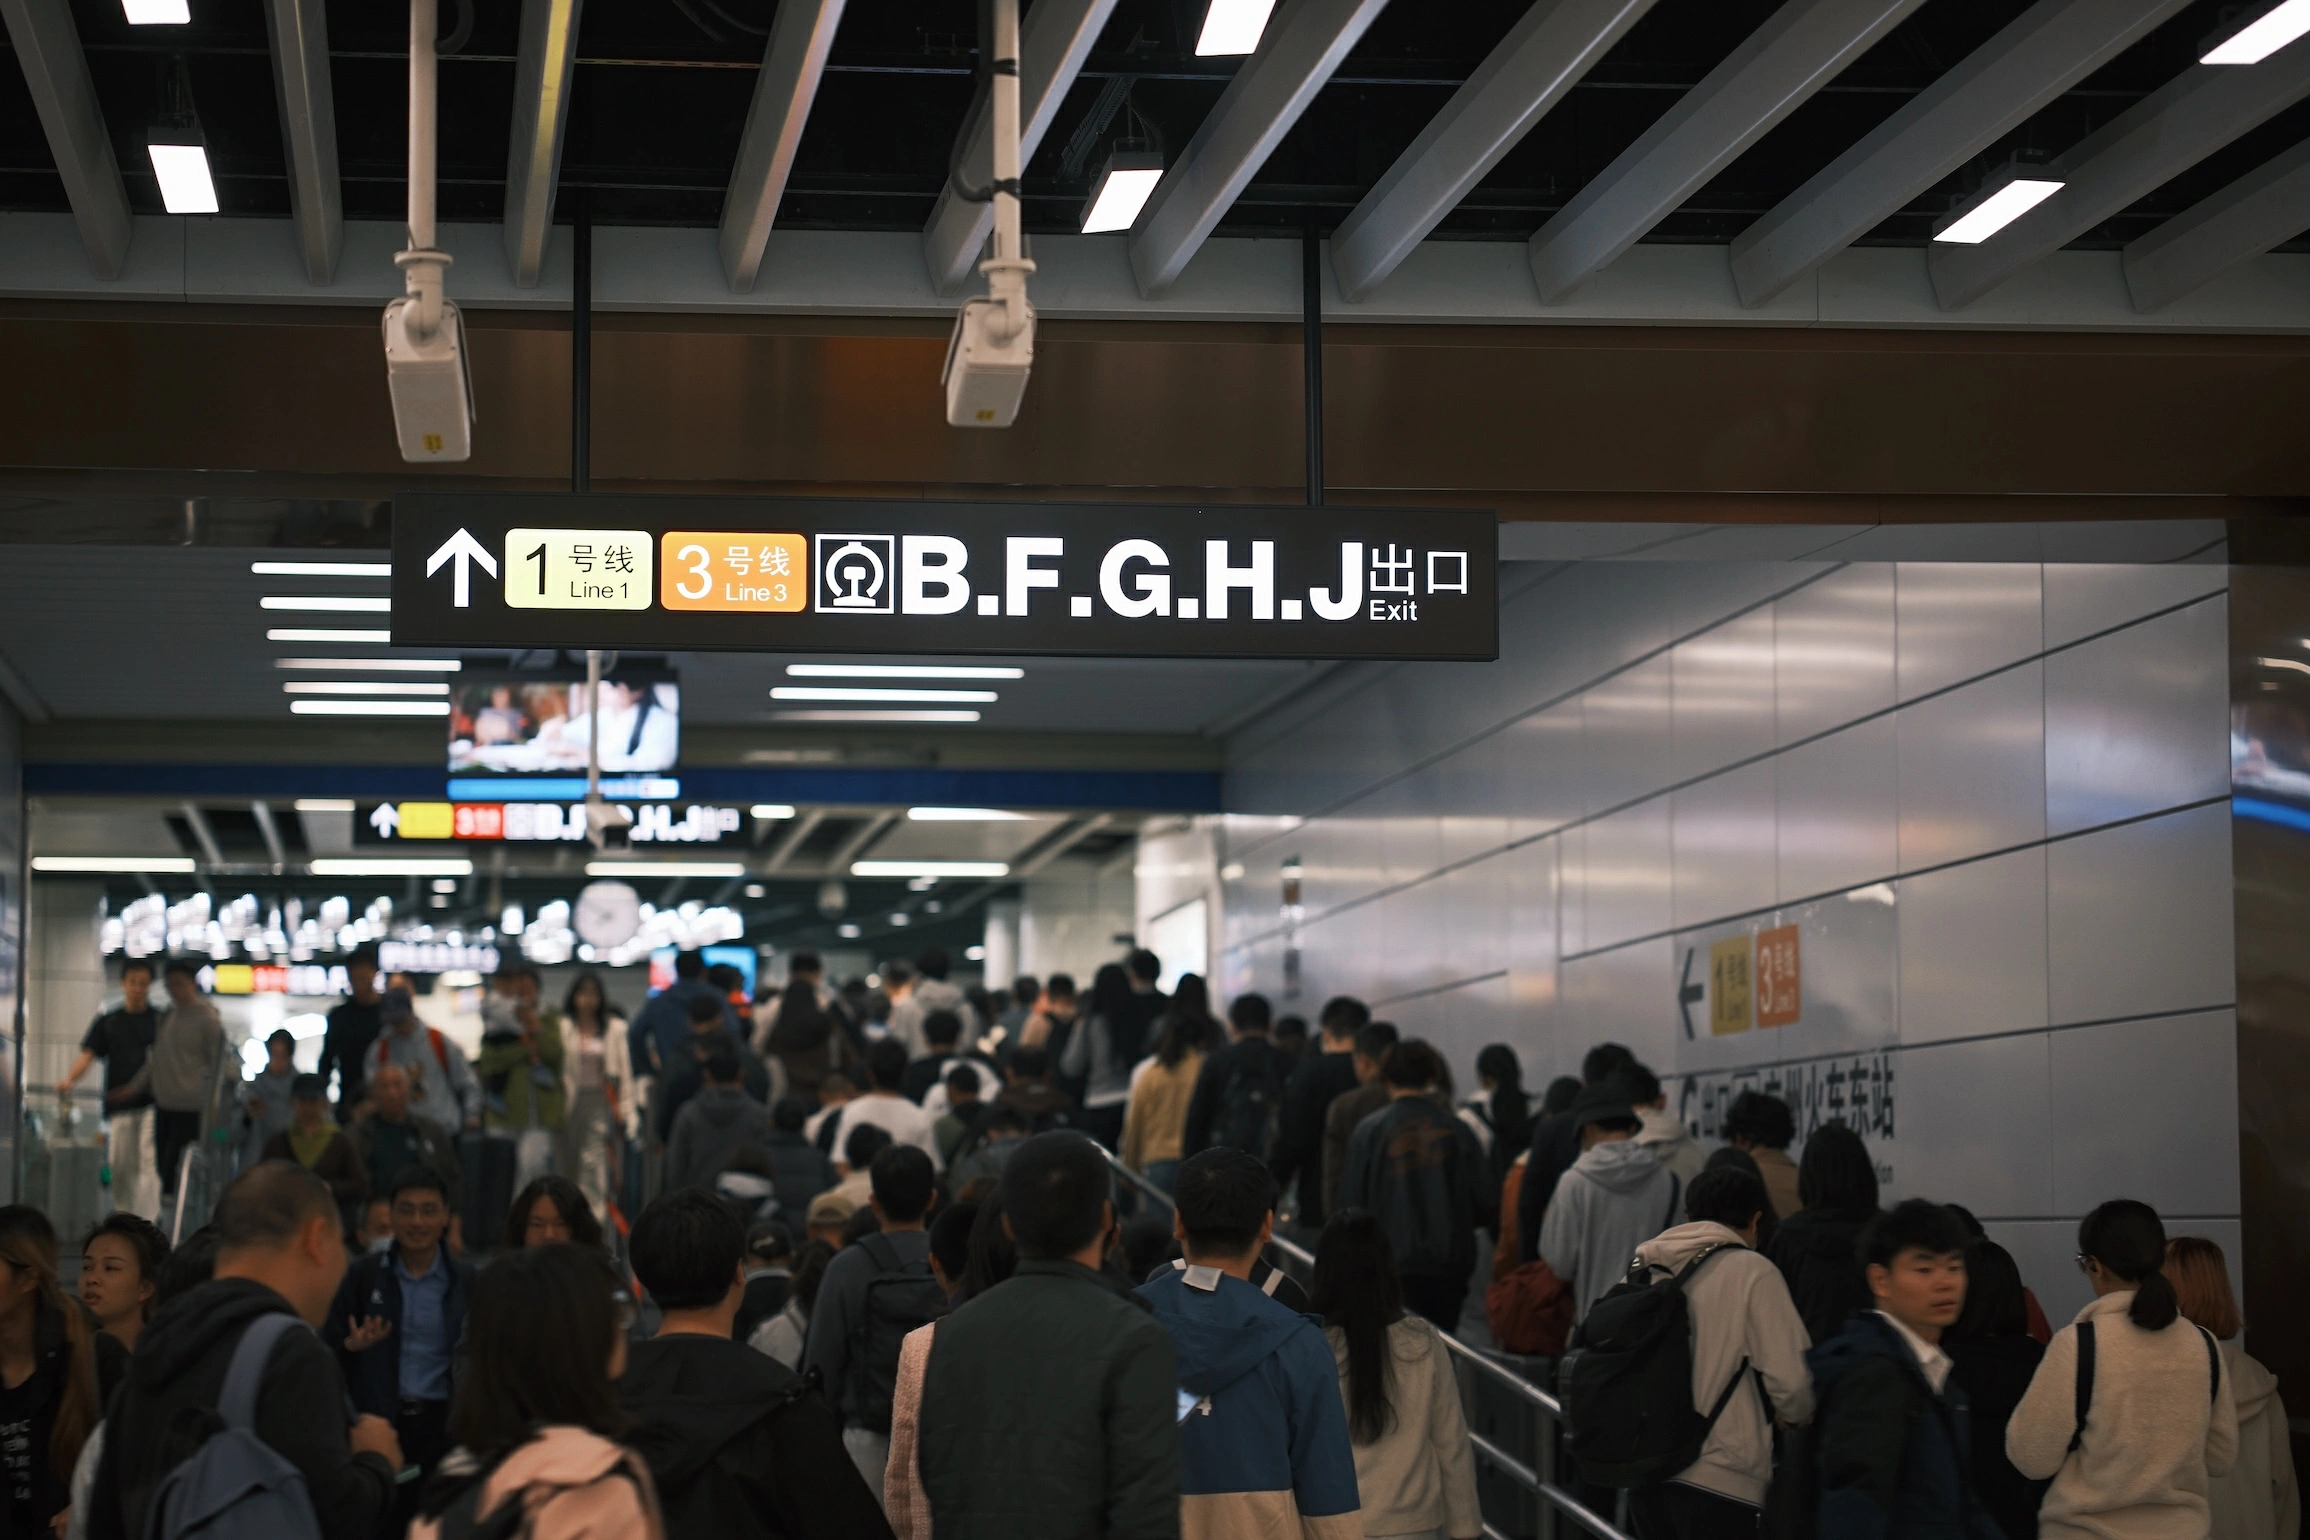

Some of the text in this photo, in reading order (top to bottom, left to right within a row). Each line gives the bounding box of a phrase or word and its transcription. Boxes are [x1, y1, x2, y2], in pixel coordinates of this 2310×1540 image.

[525, 543, 634, 595] 1 号线
[676, 544, 790, 600] 3 号线
[1369, 543, 1469, 596] 出口
[570, 580, 629, 600] Line 1
[726, 582, 788, 602] Line 3
[1369, 600, 1418, 621] Exit
